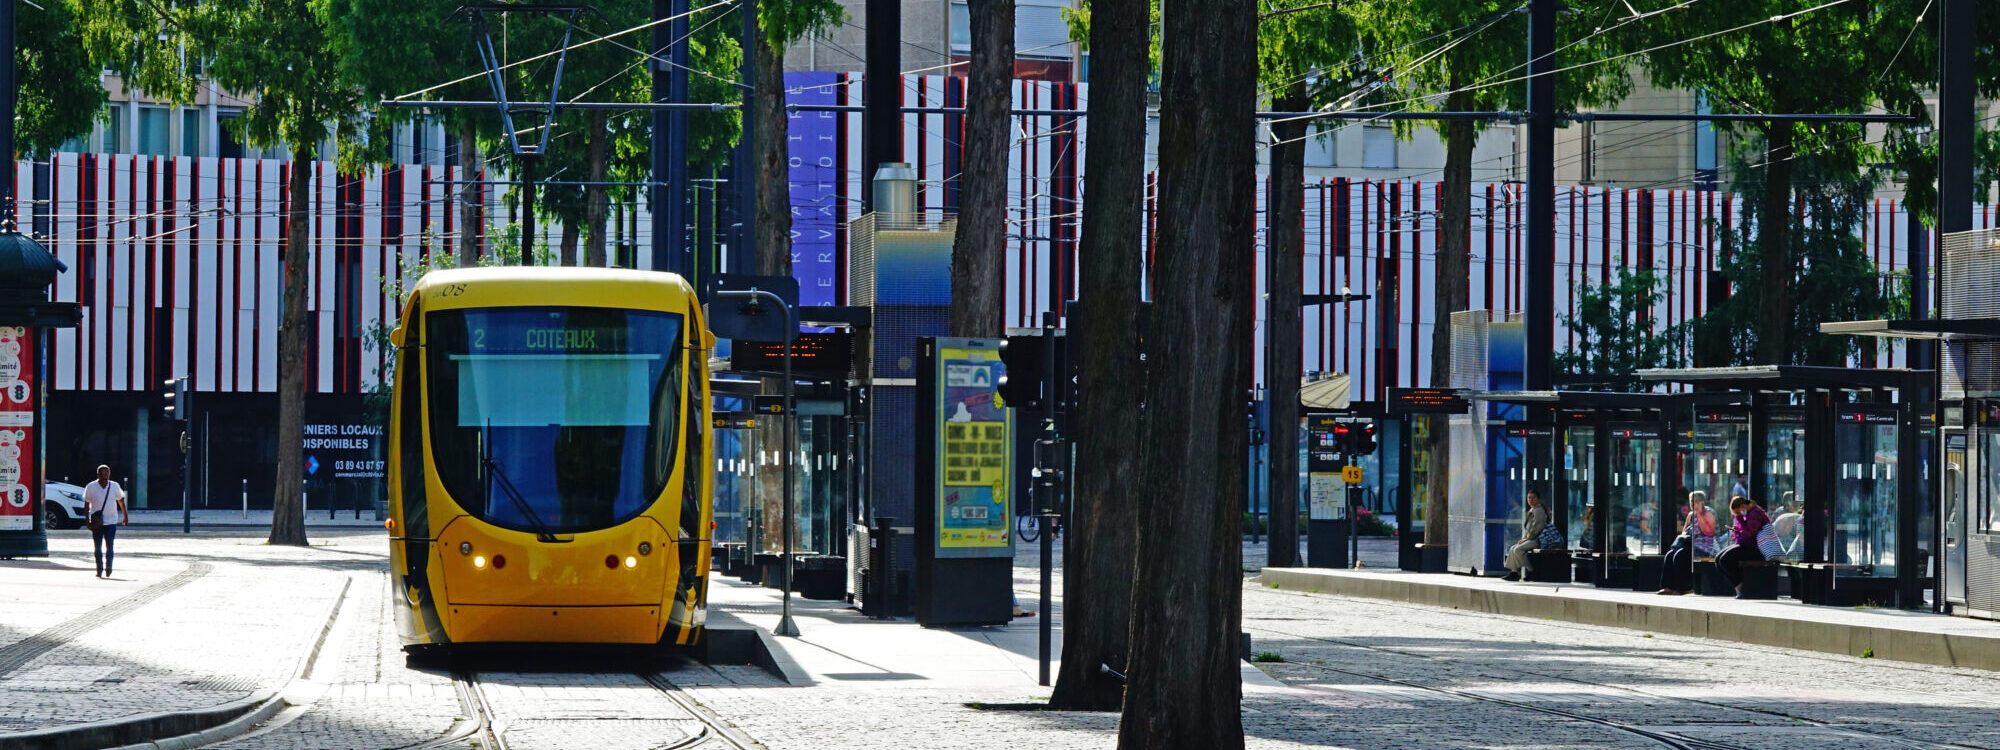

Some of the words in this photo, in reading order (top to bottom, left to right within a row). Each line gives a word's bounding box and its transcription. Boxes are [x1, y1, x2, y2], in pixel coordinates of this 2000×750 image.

[474, 329, 485, 348] 2
[526, 329, 595, 349] COTEAUX
[341, 424, 383, 436] LOCAUX
[335, 460, 344, 470] 03
[345, 460, 354, 470] 89
[355, 460, 364, 470] 43
[1348, 470, 1359, 479] 15
